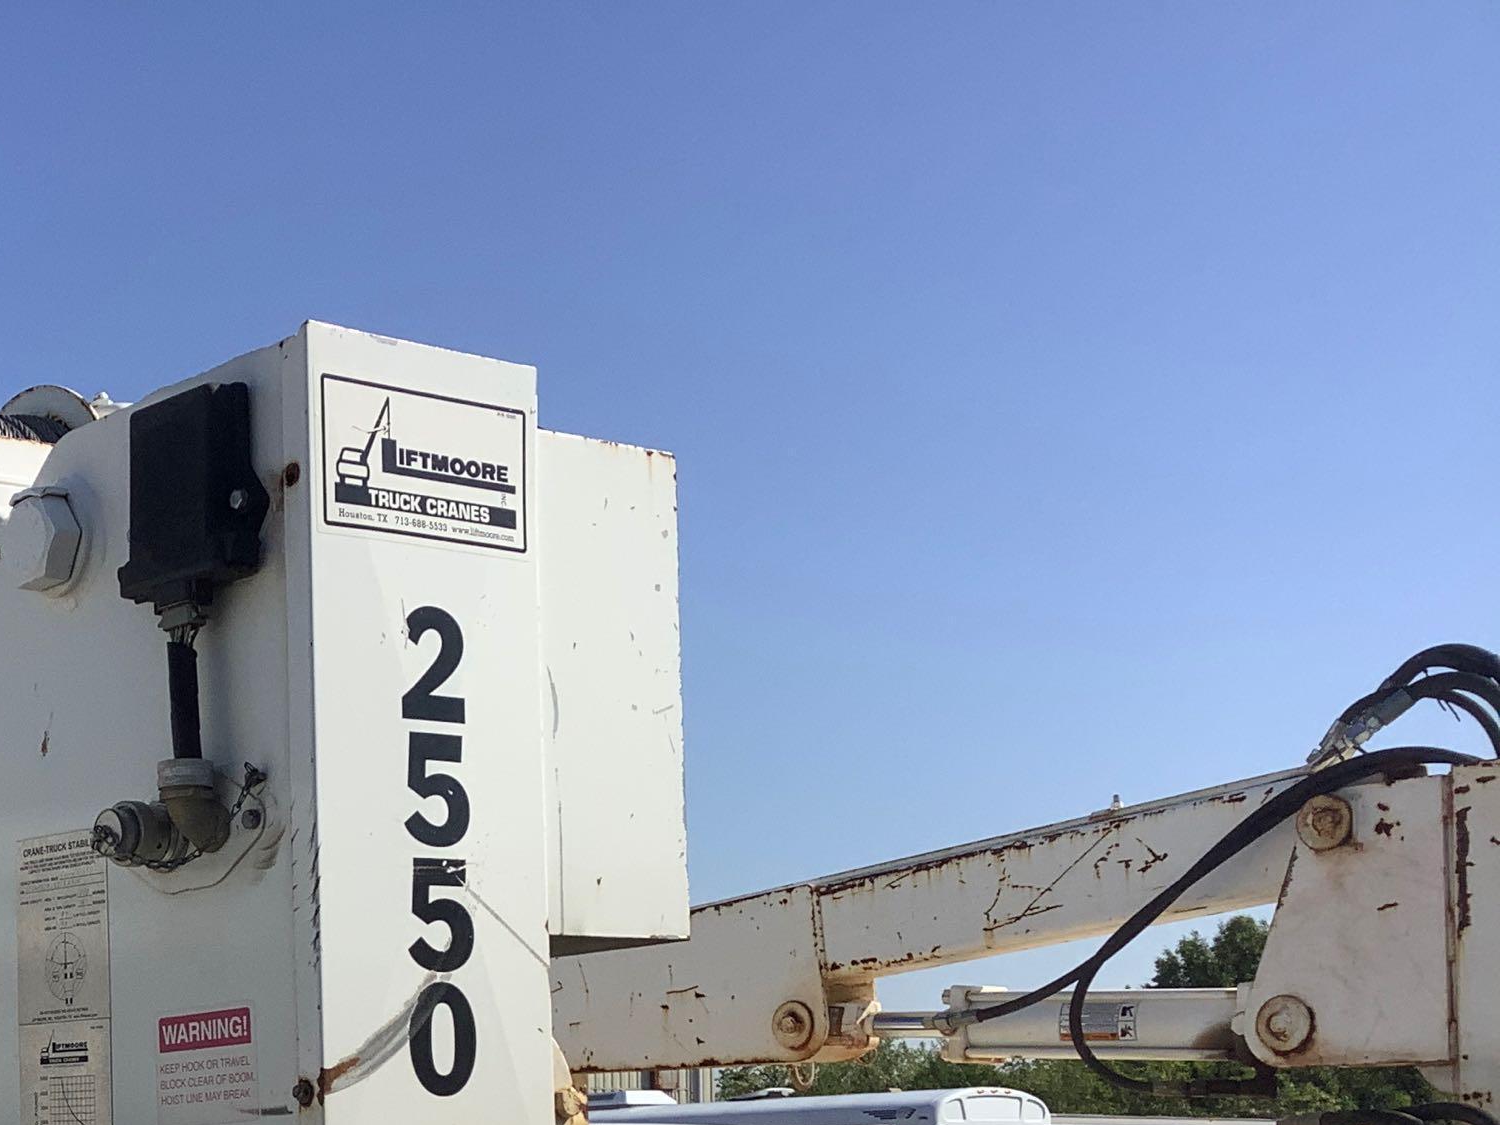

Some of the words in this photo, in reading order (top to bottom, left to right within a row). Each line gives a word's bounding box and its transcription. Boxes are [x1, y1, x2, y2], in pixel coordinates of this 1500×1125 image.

[381, 438, 509, 483] LIFTMOORE
[369, 489, 422, 512] TRUCK
[426, 498, 490, 523] CRANES
[376, 513, 388, 523] TX
[395, 516, 448, 532] 713-688-5533
[23, 843, 67, 858] CRANE-TRUCK
[401, 605, 477, 1098] 2550
[162, 1015, 248, 1045] WARNING!
[160, 1062, 180, 1074] KEEP
[182, 1061, 205, 1073] HOOK
[206, 1059, 219, 1070] OR
[220, 1055, 251, 1068] TRAVEL
[161, 1078, 188, 1090] BLOCK
[188, 1075, 214, 1088] CLEAR
[216, 1074, 227, 1085] OF
[161, 1094, 185, 1106] HOIST
[186, 1092, 203, 1104] LINE
[205, 1090, 222, 1102] MAY
[224, 1087, 251, 1100] BREAK
